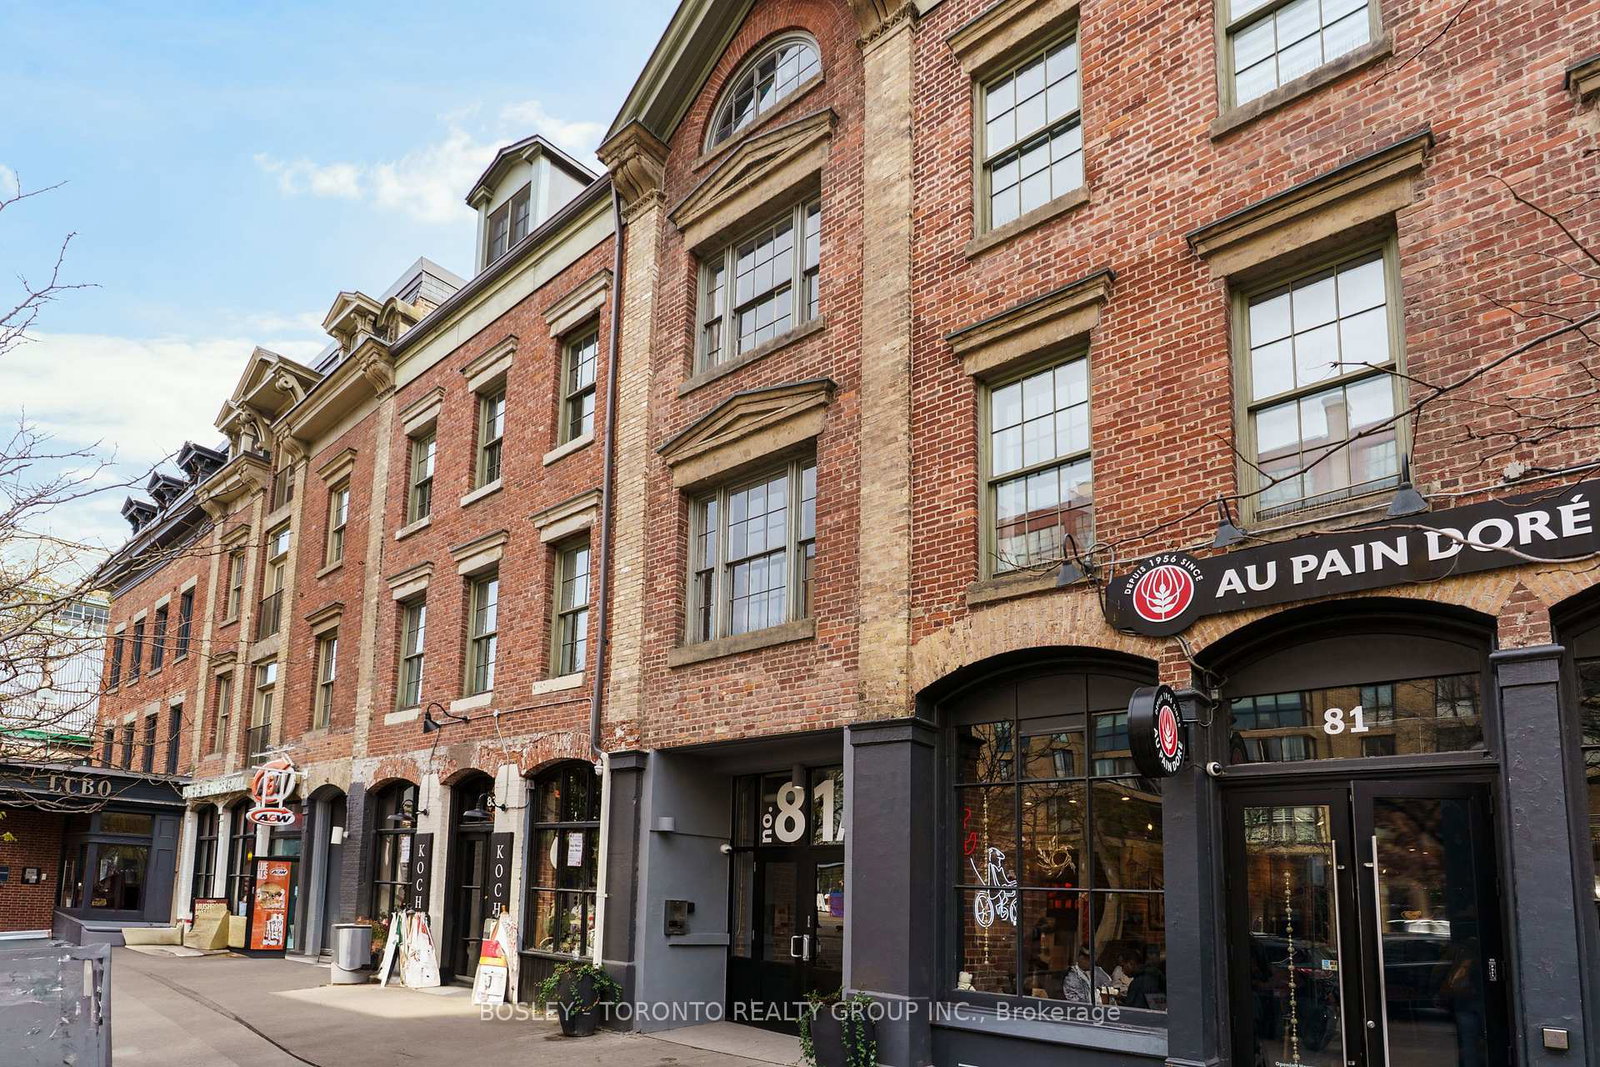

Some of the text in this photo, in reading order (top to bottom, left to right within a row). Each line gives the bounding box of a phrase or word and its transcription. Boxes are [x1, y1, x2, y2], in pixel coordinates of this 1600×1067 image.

[1215, 493, 1593, 598] AU PAIN DORÉ
[1124, 555, 1204, 595] DEPUIS 1956 SINCE
[1323, 705, 1369, 735] 81
[1153, 727, 1161, 749] AU
[1158, 749, 1173, 772] PAIN
[49, 774, 112, 797] LCBO
[258, 813, 291, 823] A&W
[762, 780, 845, 843] no. 81
[414, 844, 426, 909] KOCH
[492, 844, 504, 917] KOCH
